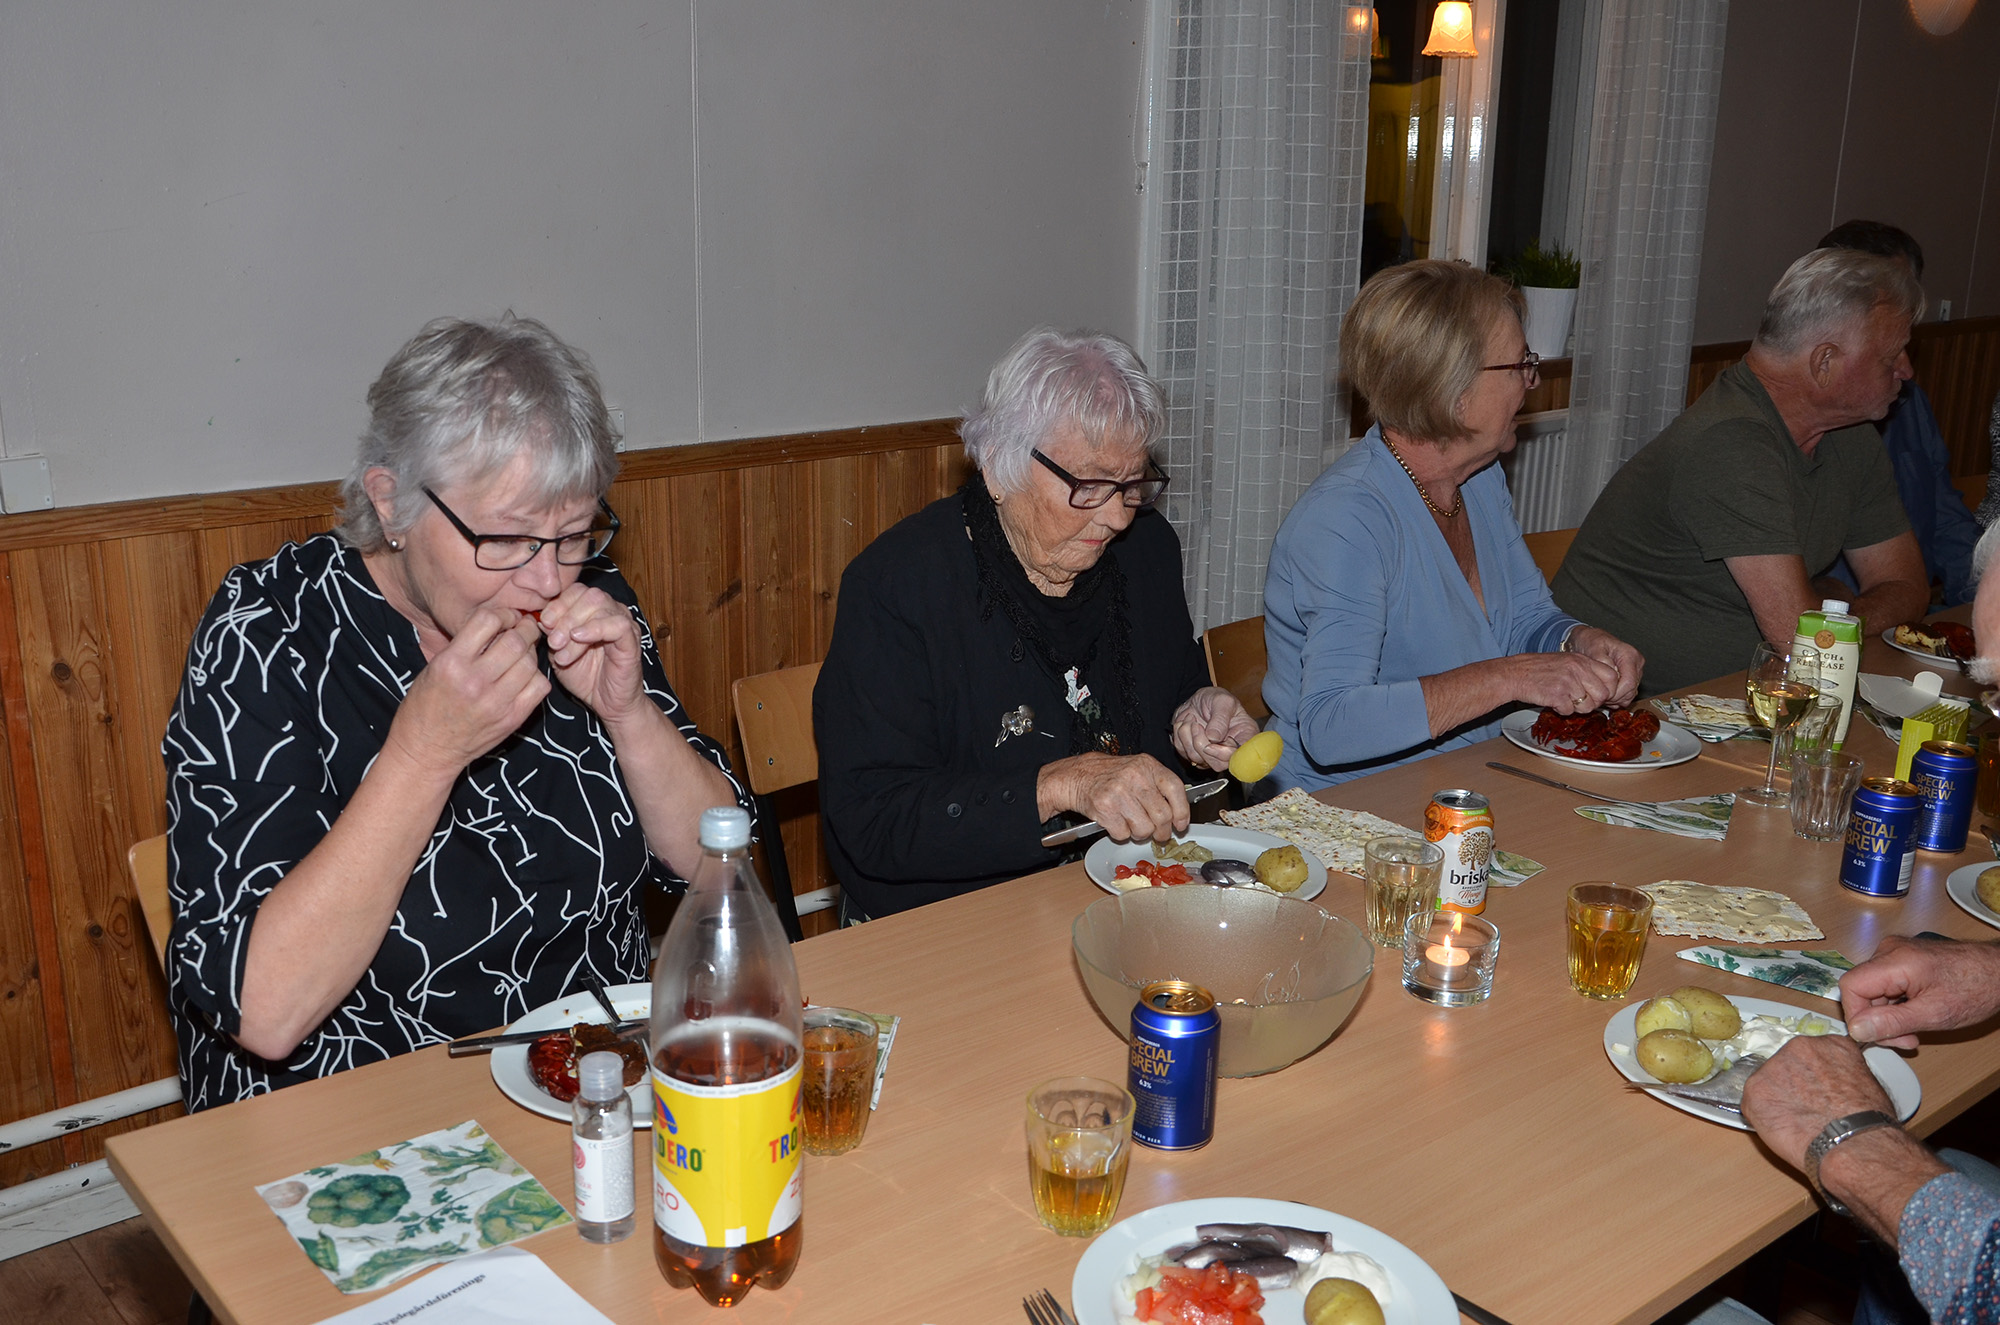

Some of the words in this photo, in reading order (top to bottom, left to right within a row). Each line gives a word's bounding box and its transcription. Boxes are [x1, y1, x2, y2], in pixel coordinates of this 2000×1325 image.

[1916, 773, 1956, 791] SPECIAL
[1917, 784, 1952, 801] BREW
[1849, 813, 1898, 839] PECIAL
[1846, 827, 1891, 854] BREW
[1131, 1050, 1170, 1077] BREW
[769, 1121, 801, 1163] TRO
